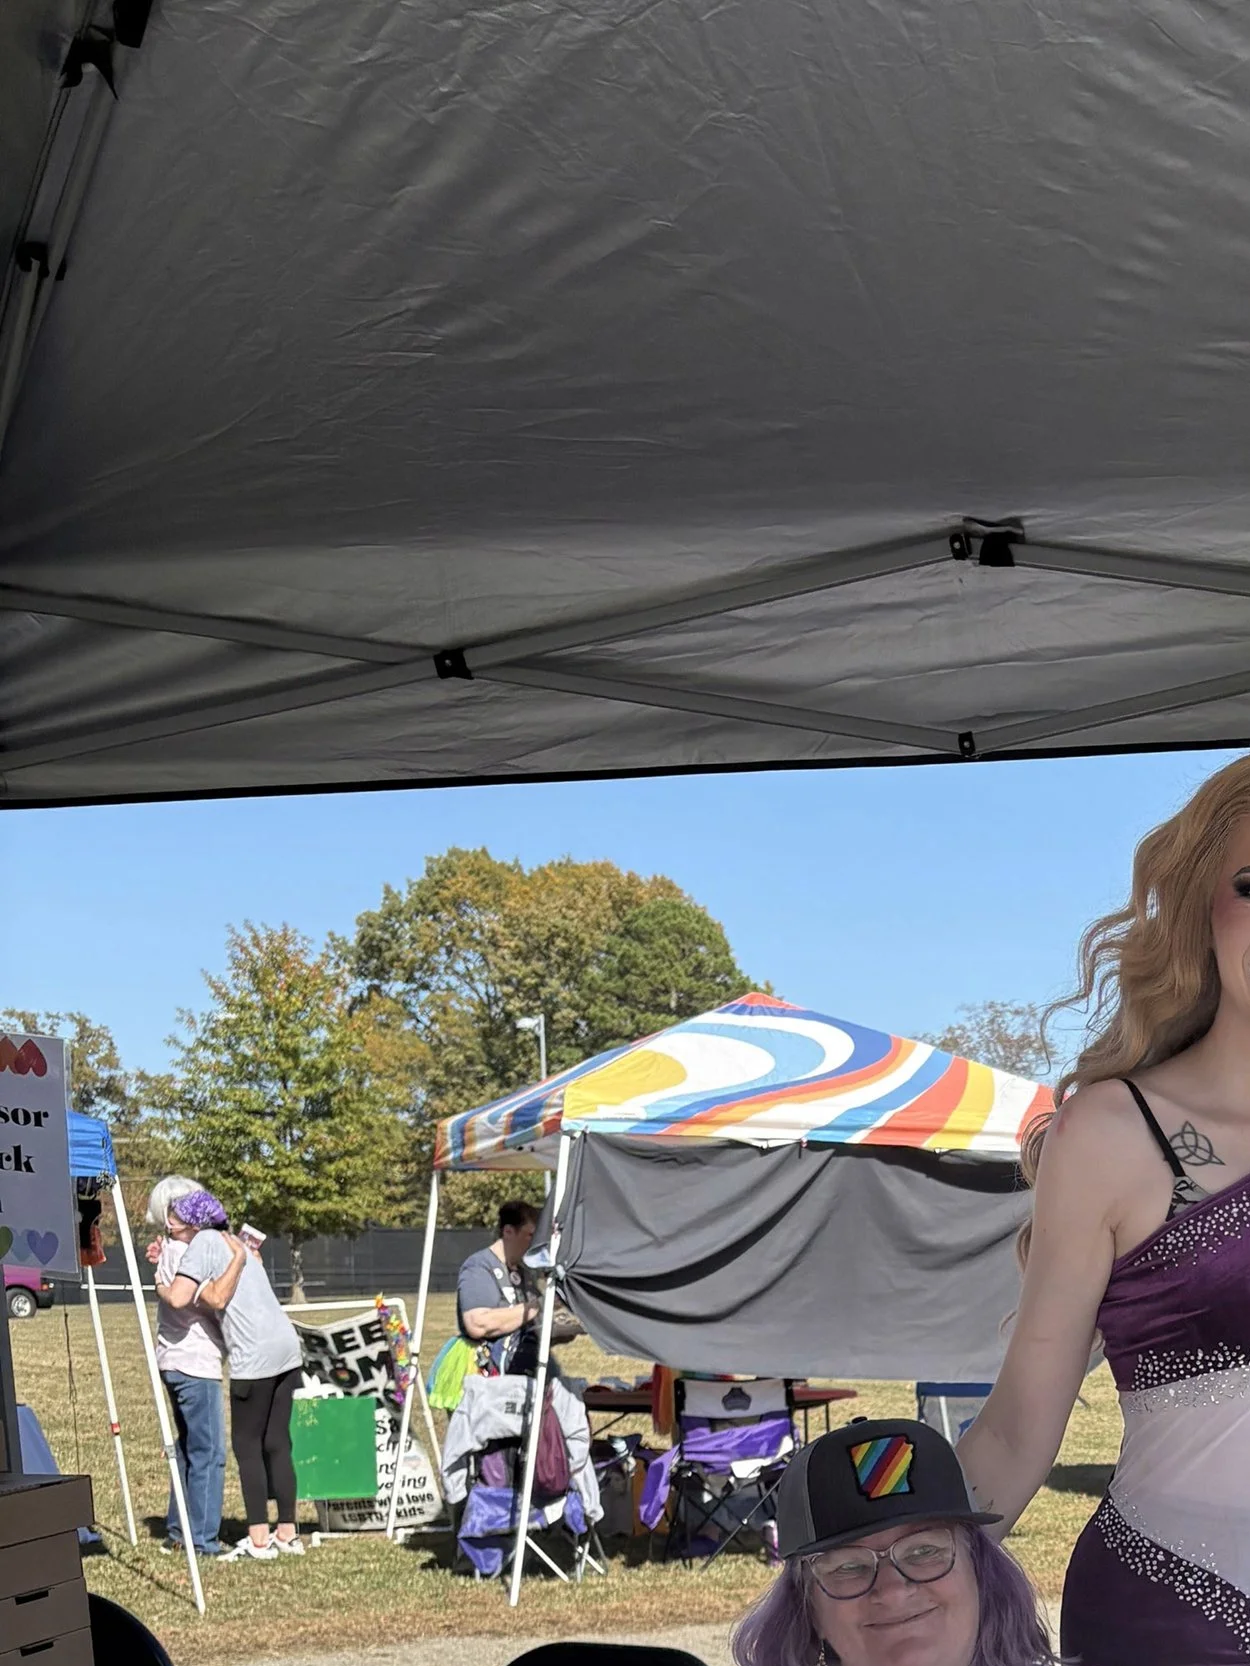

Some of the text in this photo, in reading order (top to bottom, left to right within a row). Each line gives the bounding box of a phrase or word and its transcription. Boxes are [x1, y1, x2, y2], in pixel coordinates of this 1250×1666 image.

[301, 1319, 388, 1355] REE
[407, 1491, 434, 1506] love
[396, 1506, 425, 1519] kids
